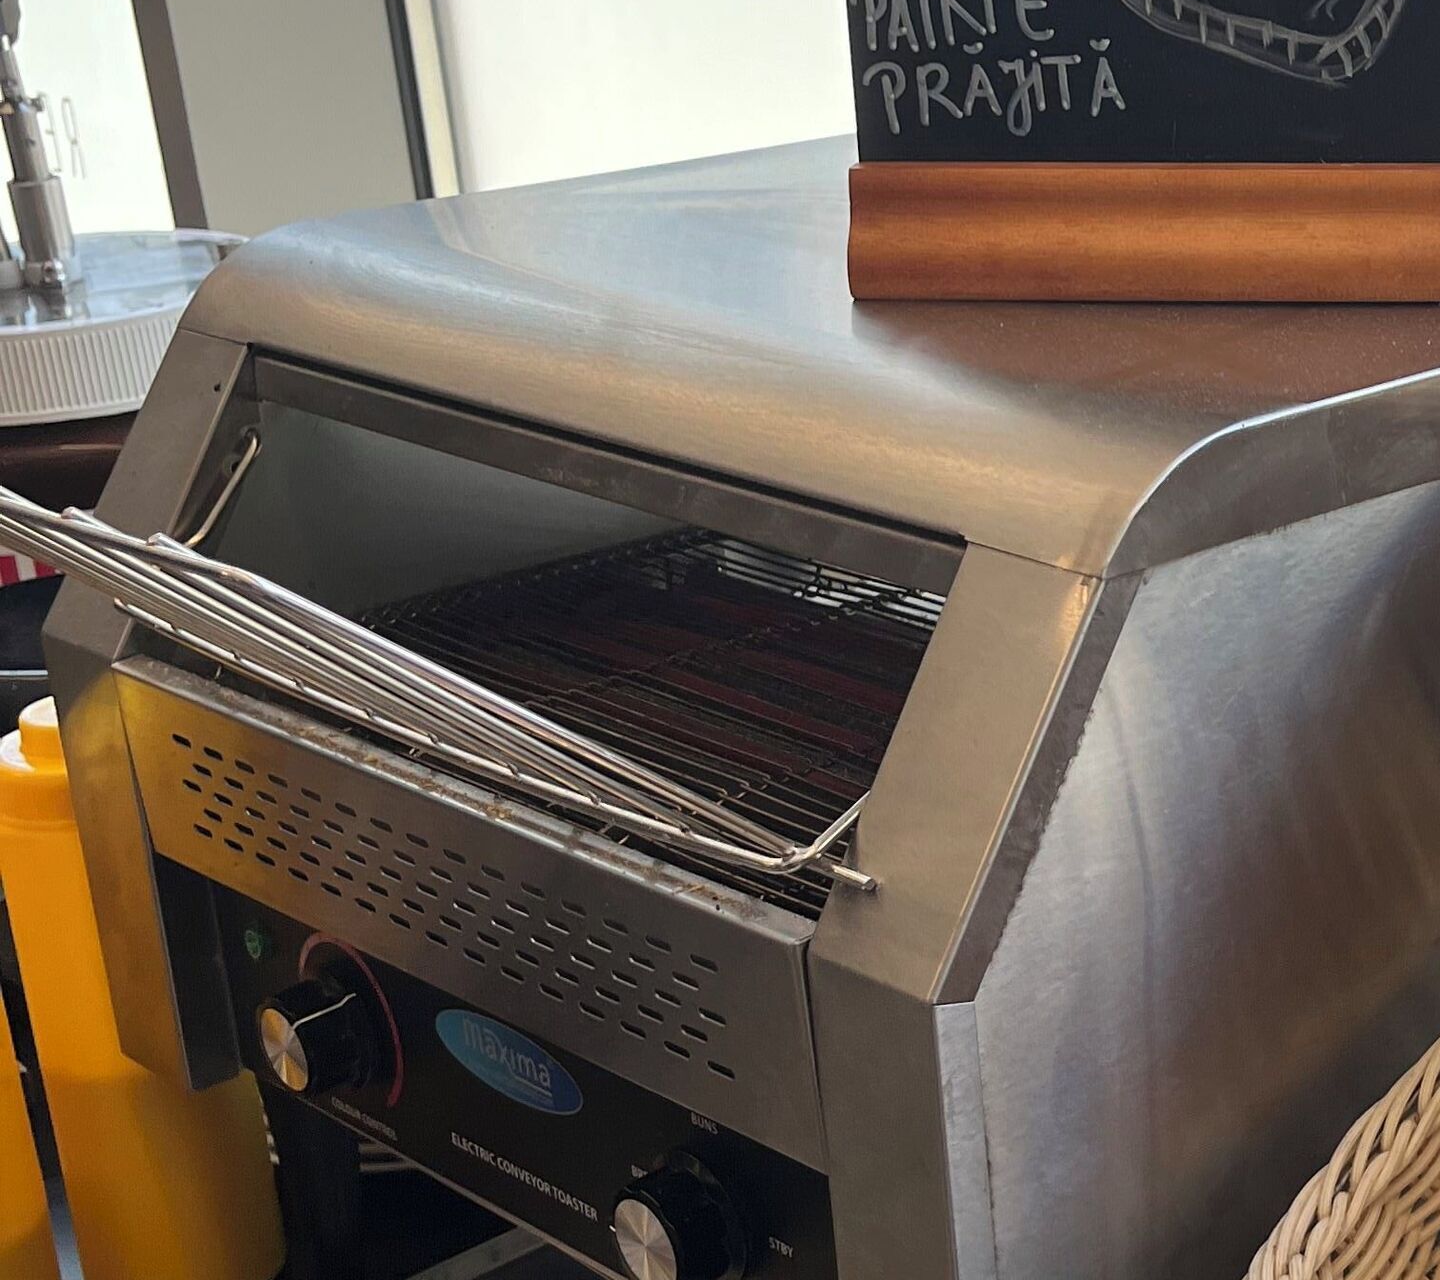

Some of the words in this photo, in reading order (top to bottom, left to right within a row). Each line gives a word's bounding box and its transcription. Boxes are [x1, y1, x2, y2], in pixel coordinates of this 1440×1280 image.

[463, 1018, 552, 1097] maxima
[690, 1111, 719, 1135] BUNS
[451, 1132, 496, 1166] ELECTRIC
[497, 1157, 551, 1195] CONVEYOR
[550, 1186, 598, 1221] TOASTER
[769, 1236, 794, 1258] STBY
